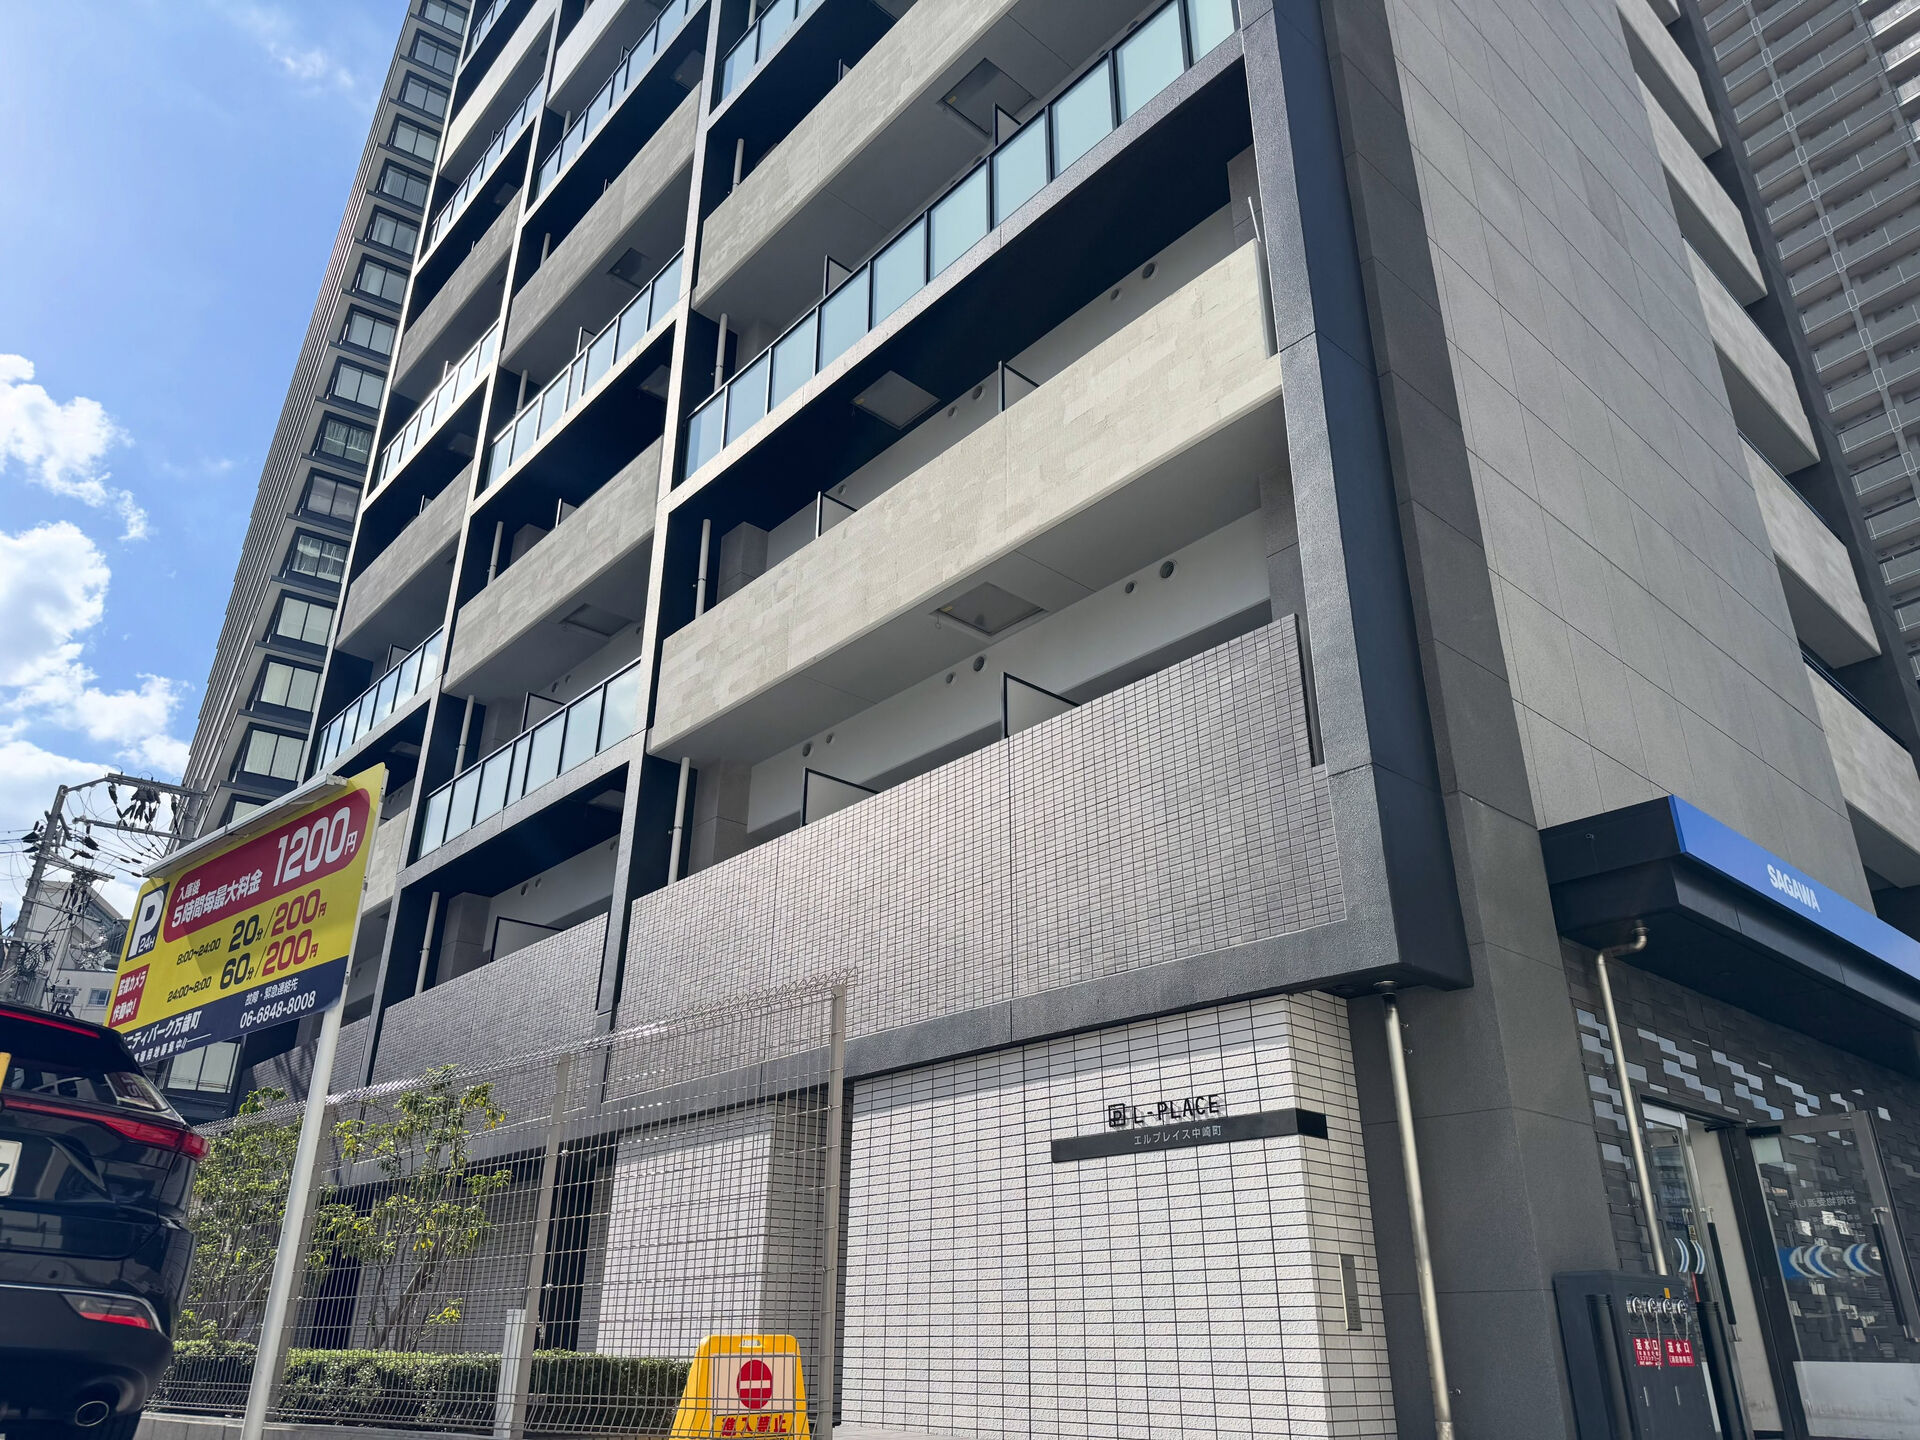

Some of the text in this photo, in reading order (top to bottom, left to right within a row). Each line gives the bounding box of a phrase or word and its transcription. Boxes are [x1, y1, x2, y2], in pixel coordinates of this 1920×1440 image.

[171, 868, 263, 928] 5時間毎最大料金
[176, 878, 201, 902] 入庫後
[1766, 863, 1821, 913] SAGAWA
[127, 889, 165, 959] P
[138, 935, 156, 953] 24H
[116, 970, 147, 997] 監視カメラ
[111, 998, 137, 1023] 作動中!
[239, 991, 317, 1029] 06-6848-8008
[124, 1010, 202, 1050] ニティパーク万歳町
[1133, 1125, 1221, 1145] エルプレイス中崎町
[721, 1414, 787, 1436] 進入禁止
